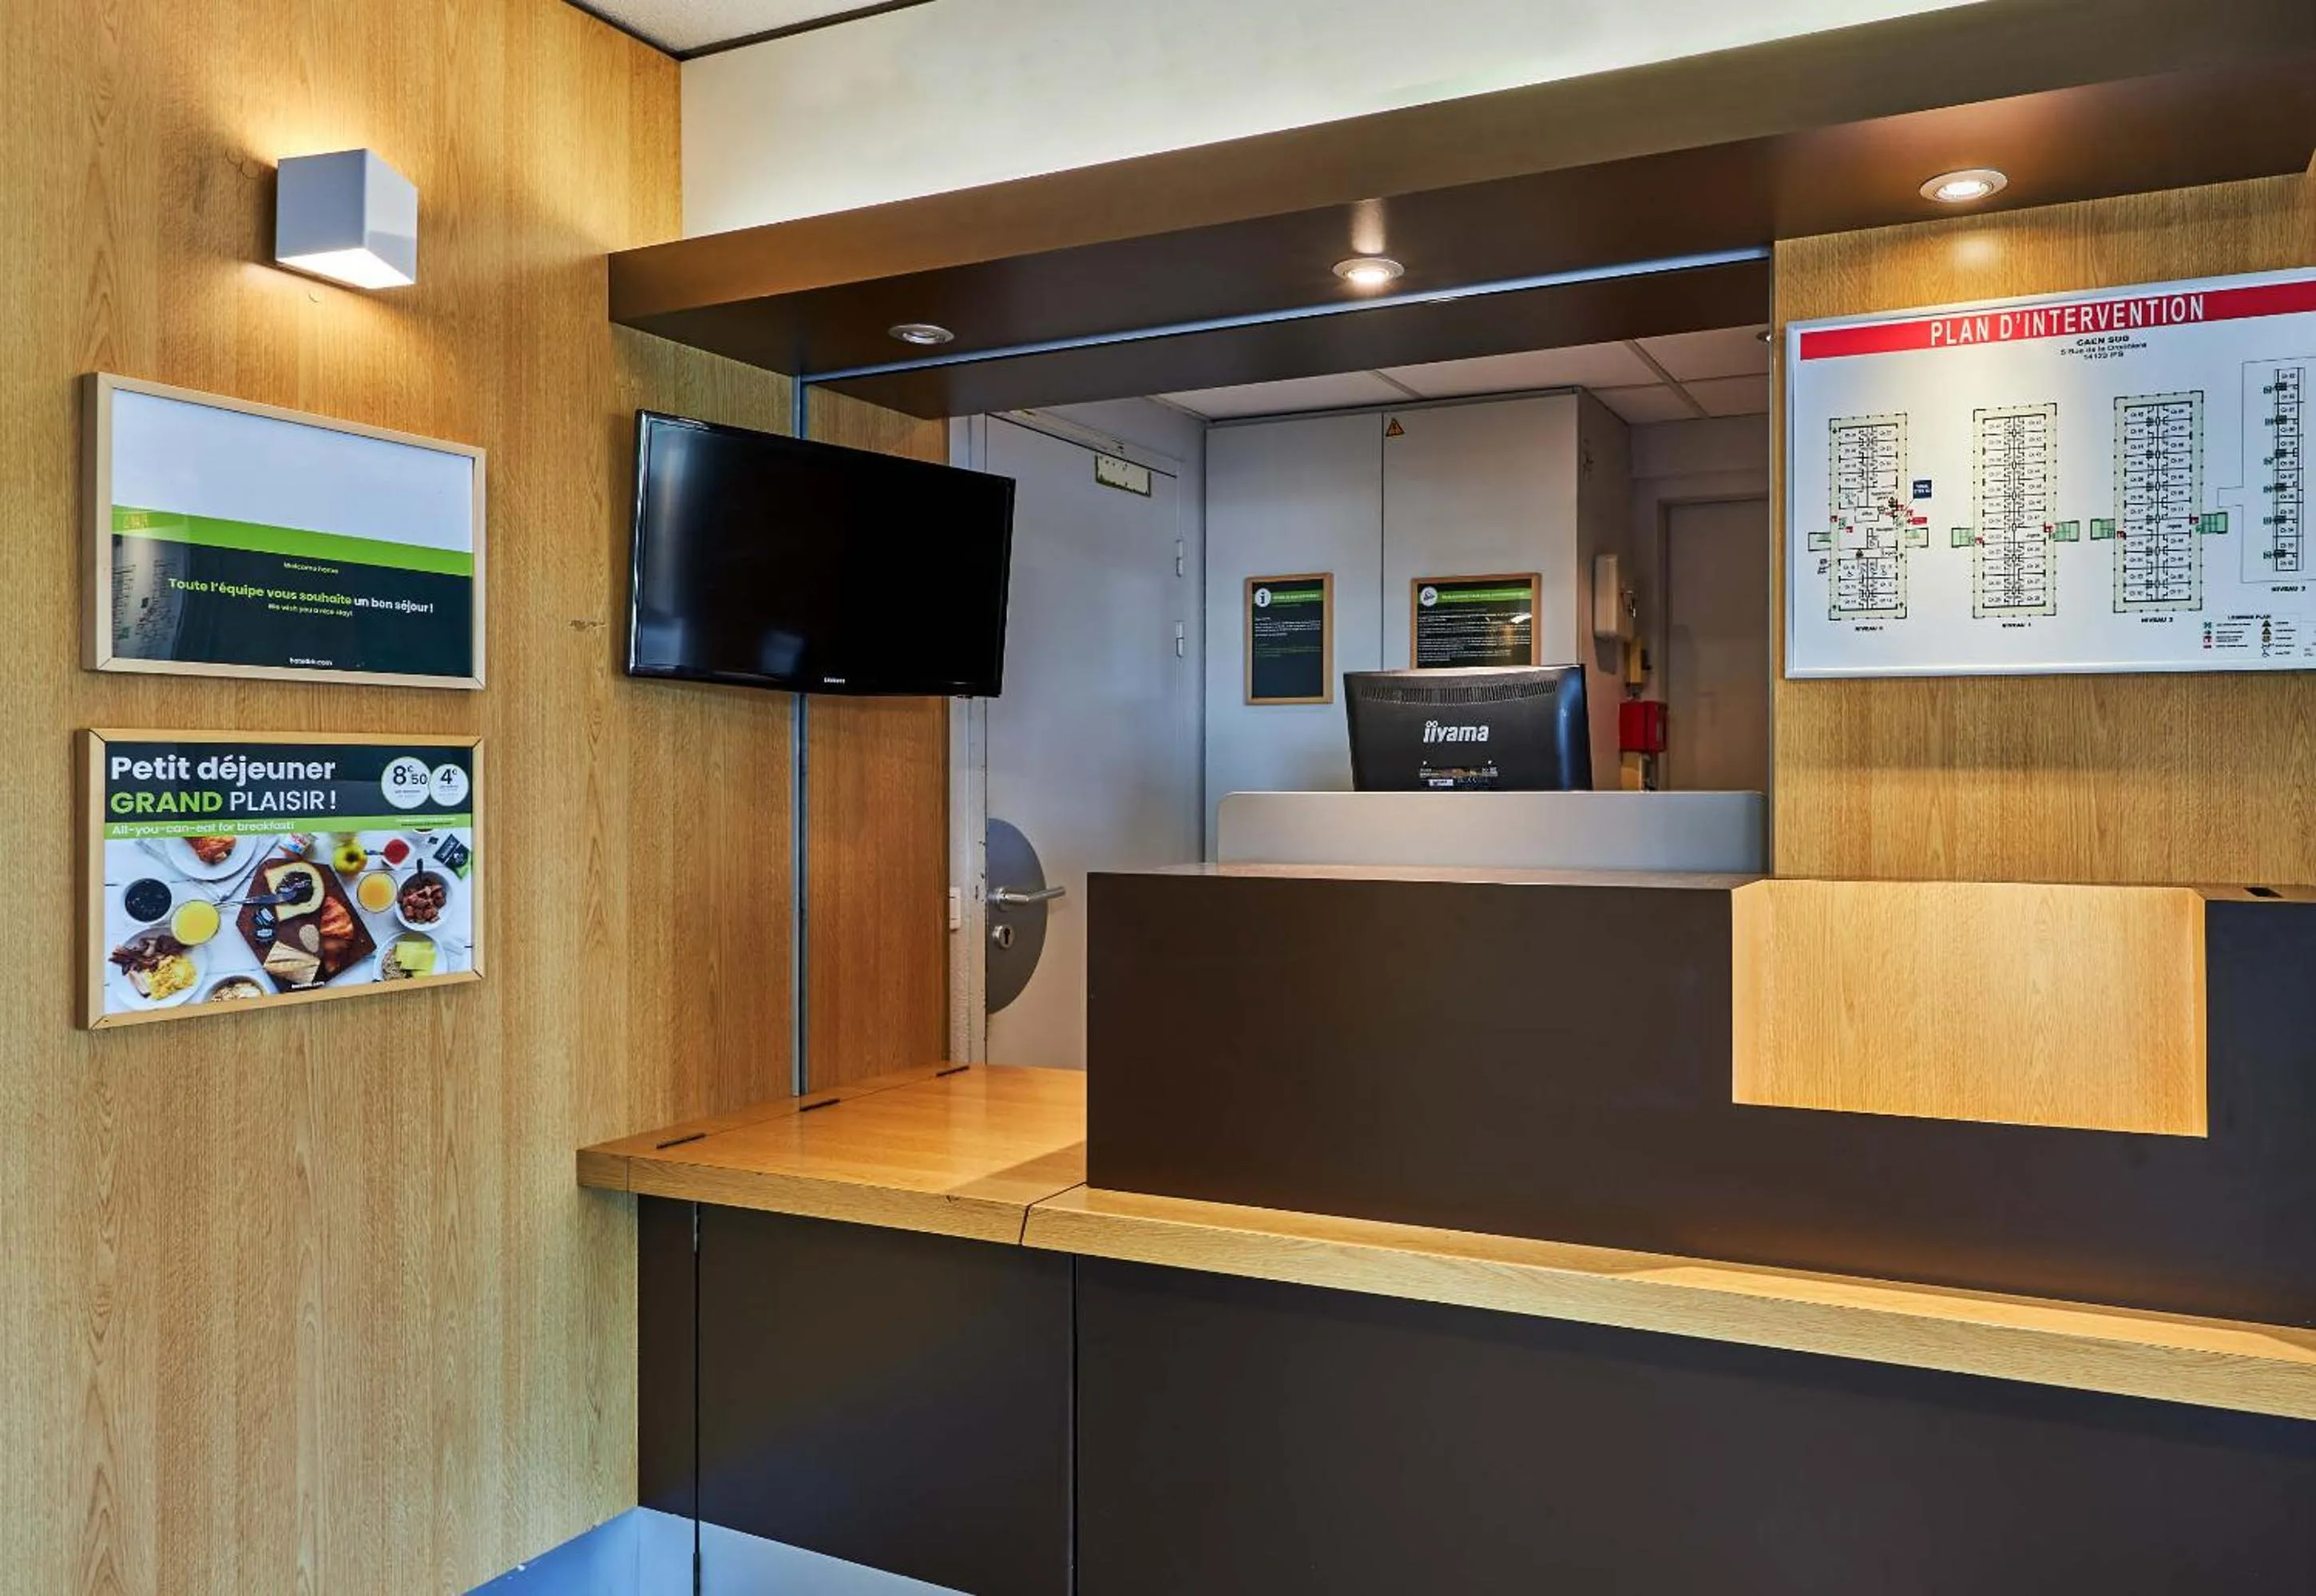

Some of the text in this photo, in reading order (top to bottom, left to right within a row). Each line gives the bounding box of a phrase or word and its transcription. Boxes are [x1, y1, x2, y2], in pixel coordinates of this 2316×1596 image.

[1930, 295, 2204, 347] PLAN D'INTERVENTION
[169, 578, 208, 592] Toute
[210, 581, 265, 598] l'équipe
[267, 588, 297, 600] vous
[299, 592, 352, 605] souhaite
[354, 597, 369, 607] un
[371, 597, 393, 609] bon
[1423, 720, 1489, 743] iiyama
[110, 754, 335, 787] Petit déjeuner
[110, 791, 224, 814] GRAND
[229, 790, 325, 812] PLAISIR
[112, 820, 295, 836] All-you-can-eat for breakfast!
